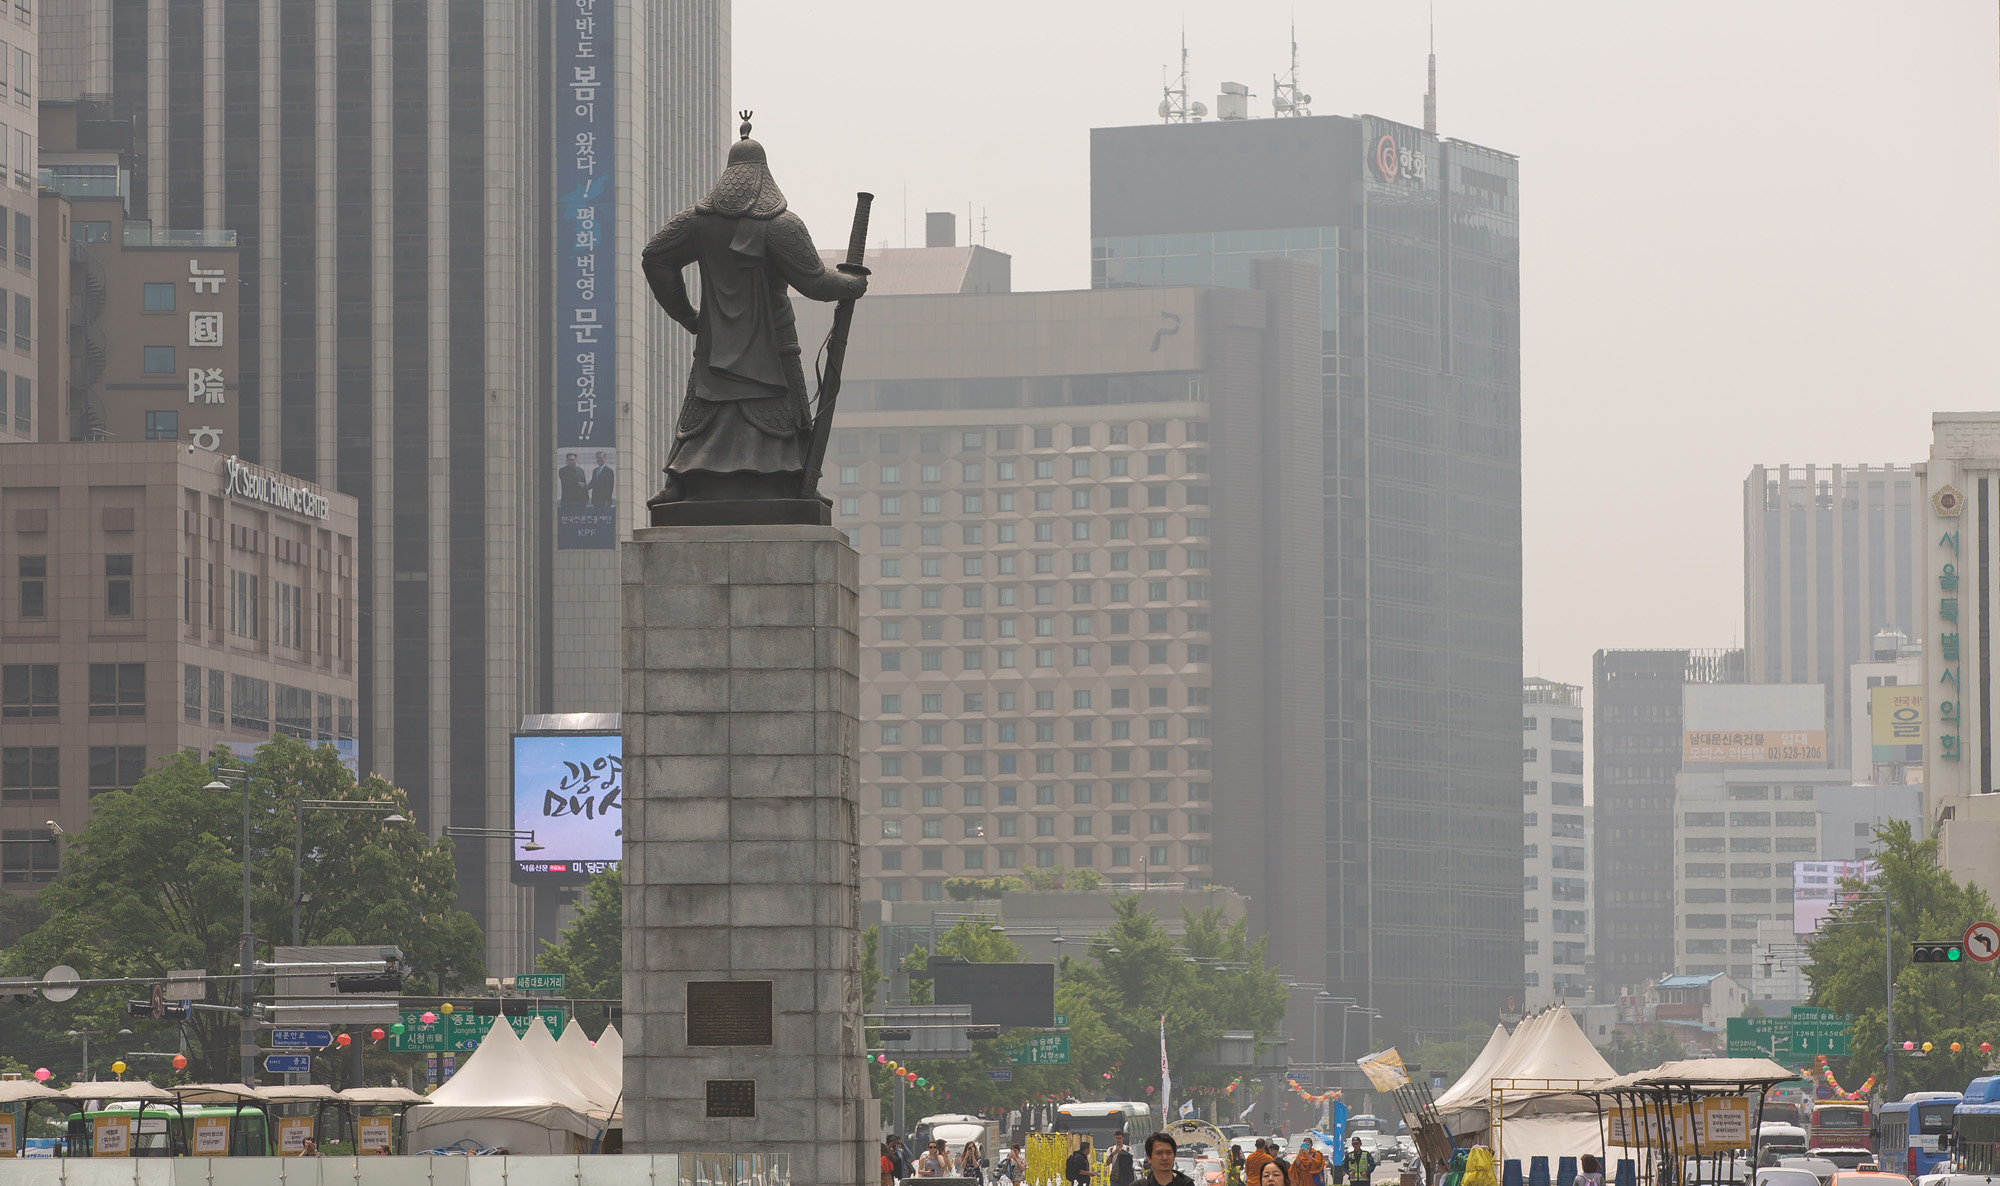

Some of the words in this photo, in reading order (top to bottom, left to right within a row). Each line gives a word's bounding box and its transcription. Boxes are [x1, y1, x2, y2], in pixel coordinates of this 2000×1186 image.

[569, 66, 602, 123] 봄이
[1400, 147, 1427, 182] 한화
[569, 308, 602, 343] 문
[577, 528, 597, 537] KPF
[1938, 531, 1961, 761] 서울특별시의회
[1781, 732, 1808, 745] 임대
[1689, 747, 1725, 760] 오피스
[1768, 746, 1781, 761] 02)
[1783, 746, 1821, 761] 528-1206
[407, 1014, 440, 1025] 숭문
[512, 1015, 558, 1027] 서대역
